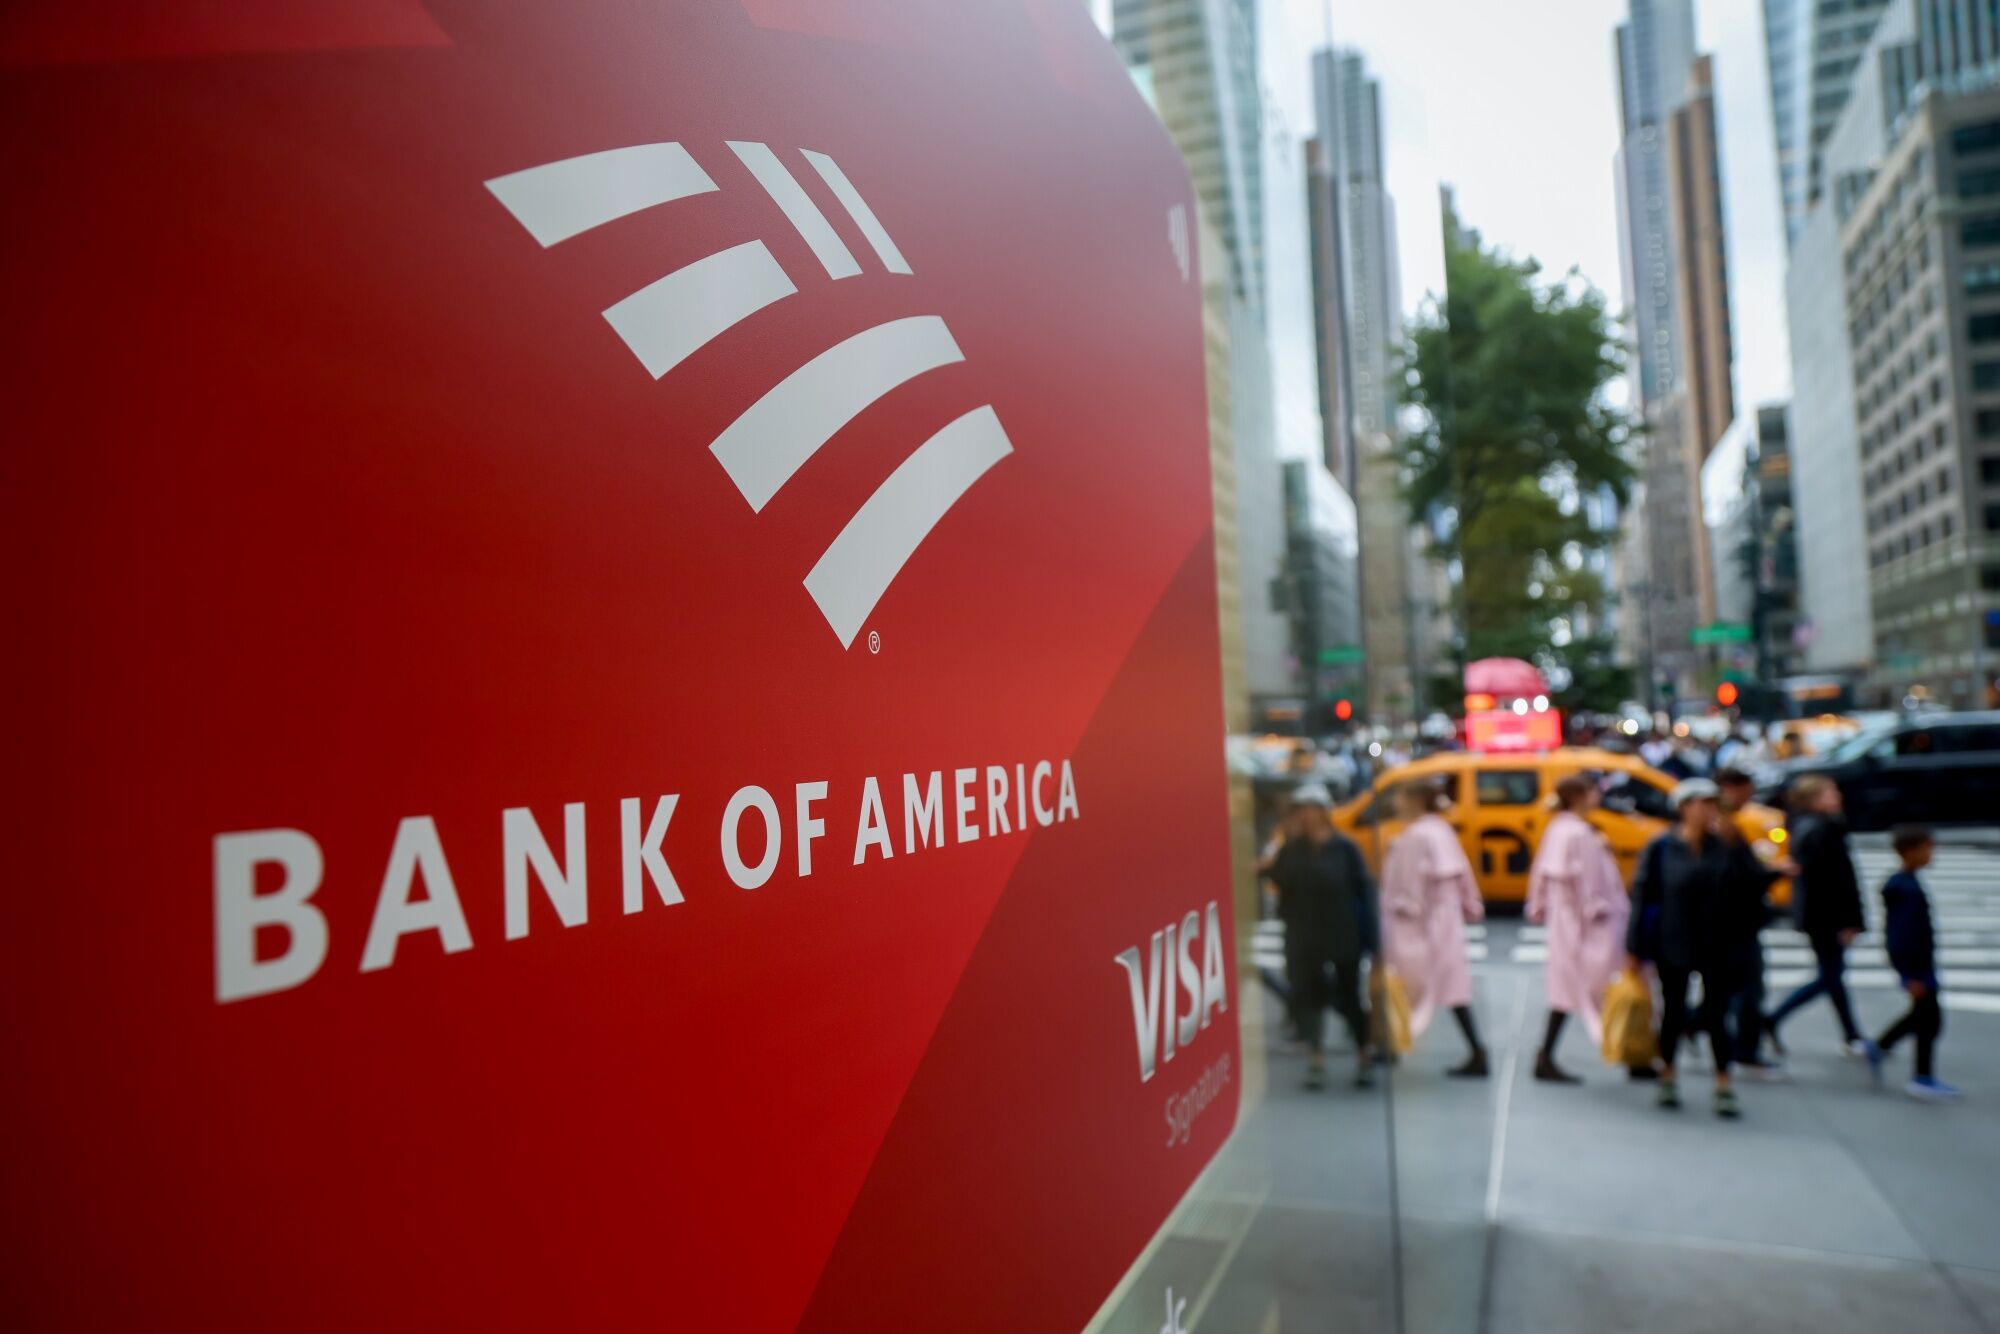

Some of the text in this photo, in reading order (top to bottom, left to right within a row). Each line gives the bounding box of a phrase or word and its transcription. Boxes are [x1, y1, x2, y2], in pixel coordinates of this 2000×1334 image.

[213, 759, 1080, 1002] BANK OF AMERICA
[1114, 900, 1228, 1083] VISA
[1164, 1052, 1231, 1147] Signature
